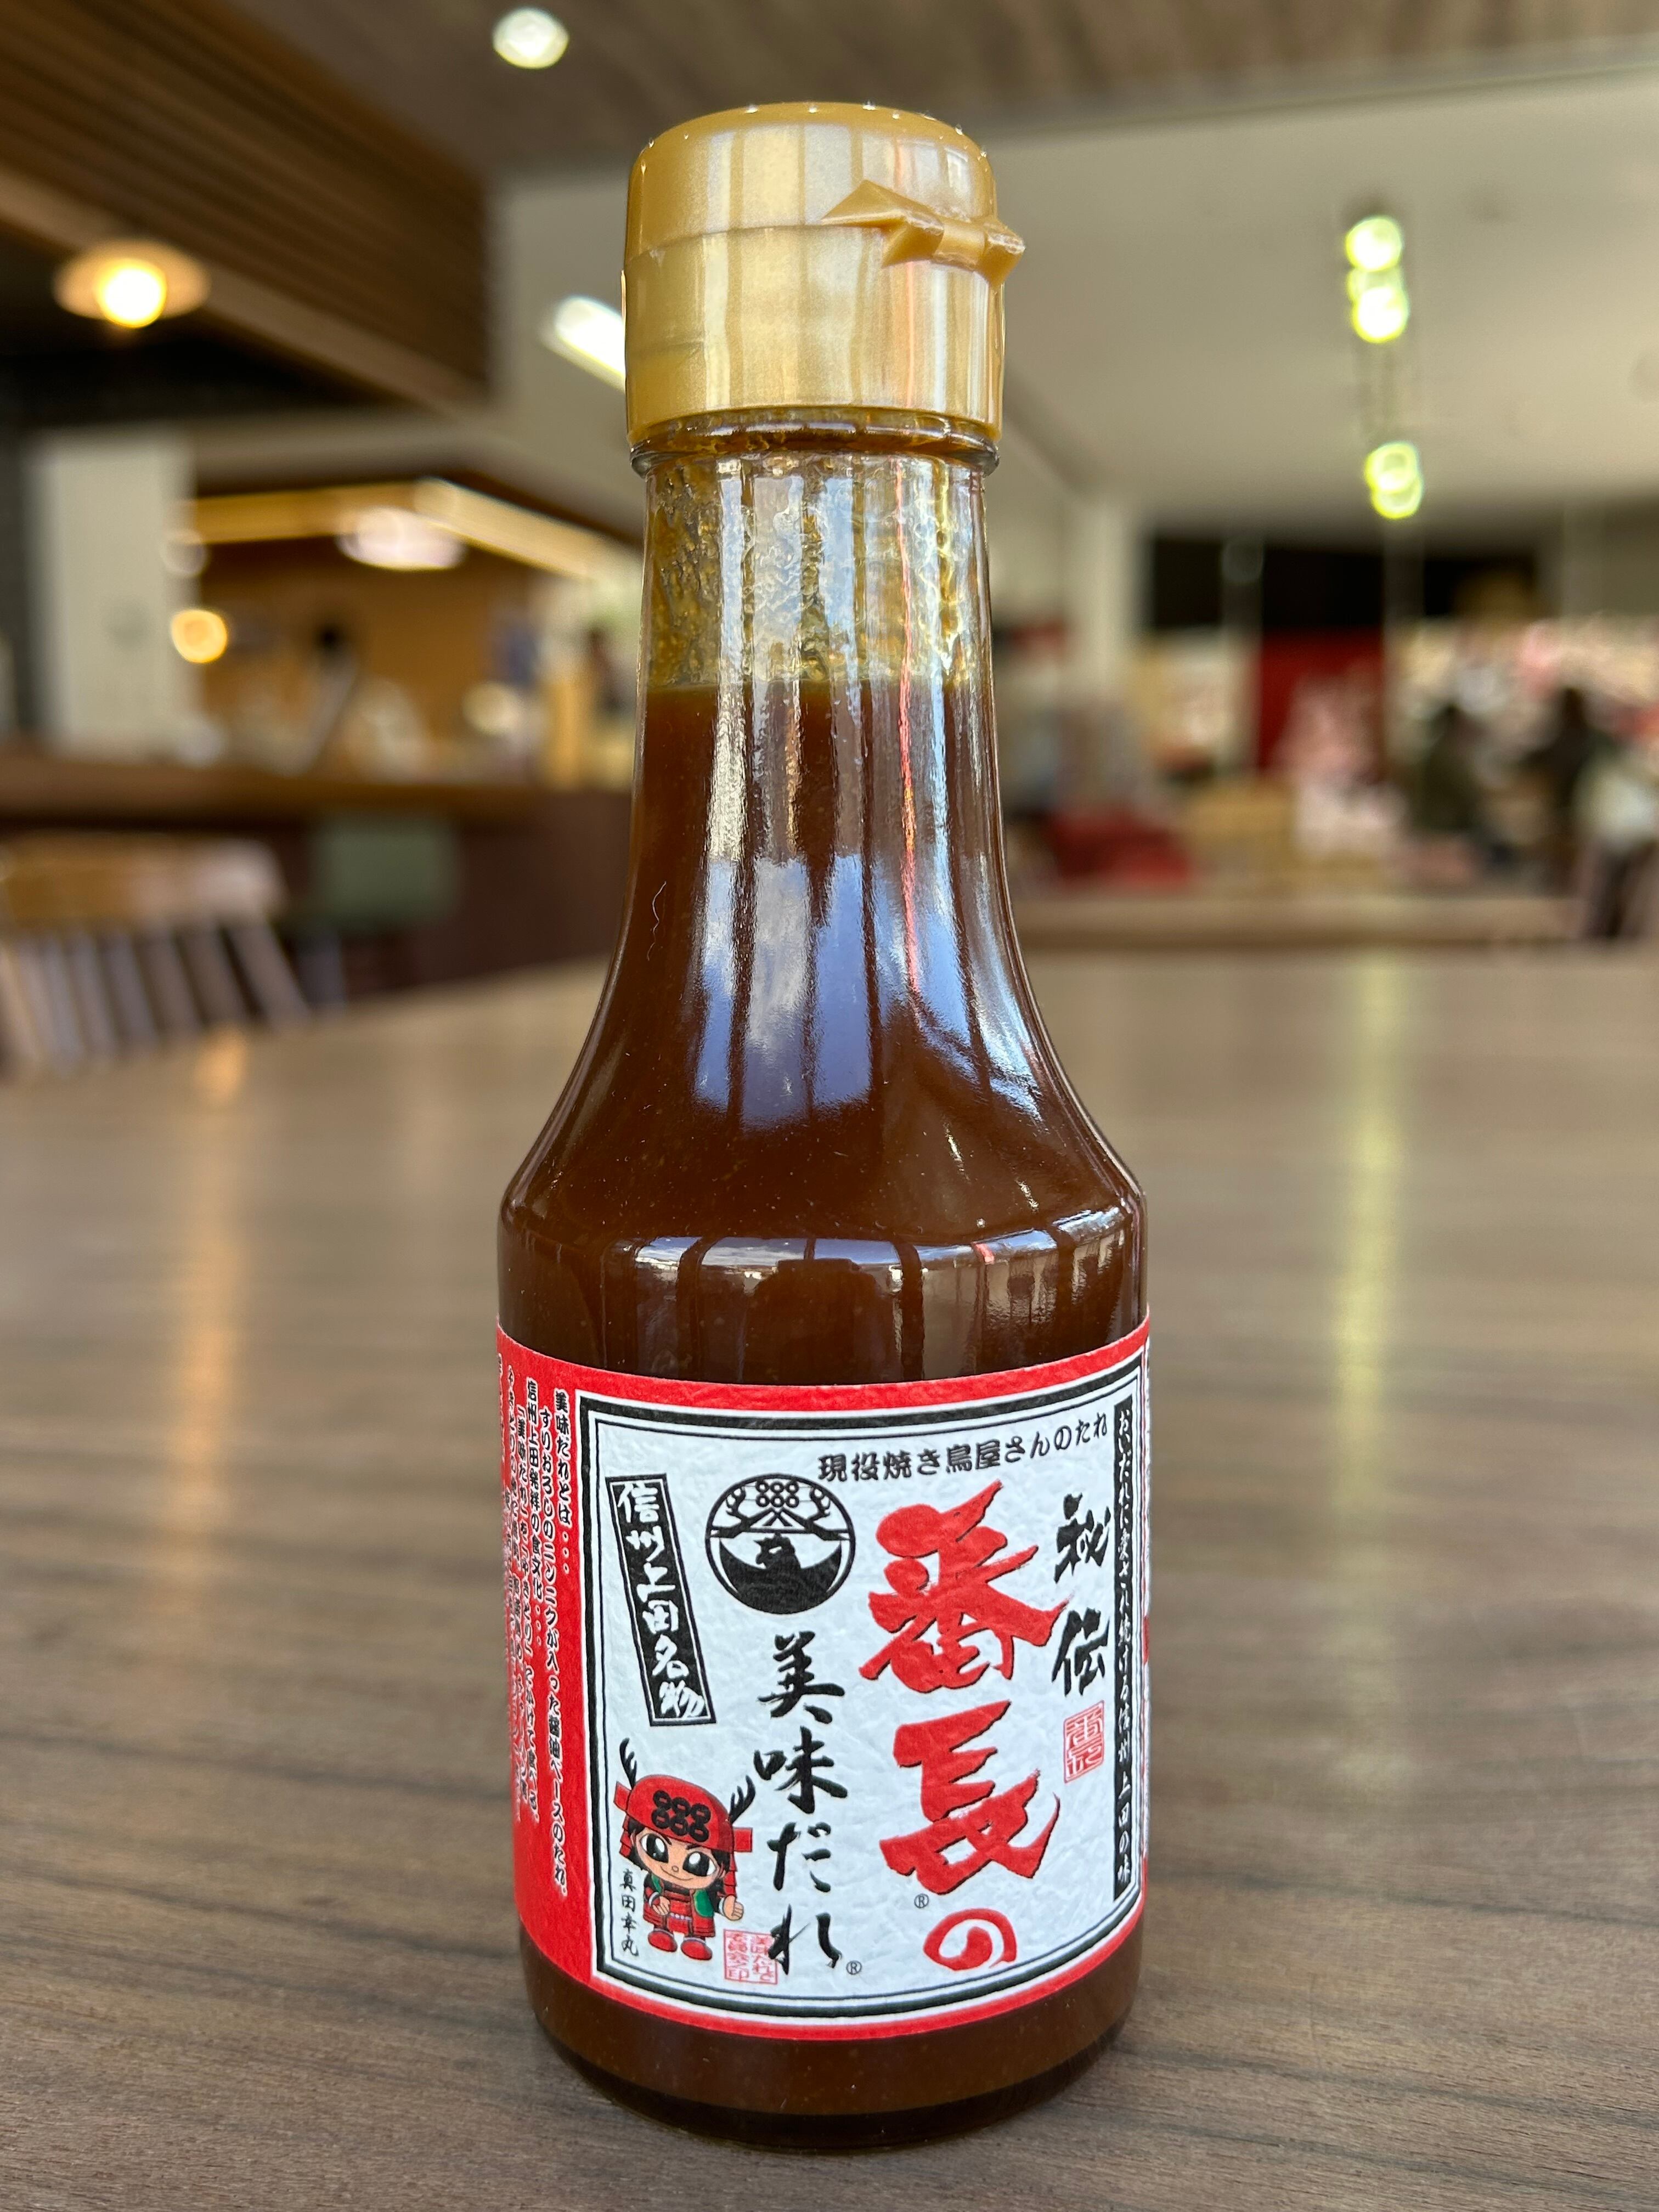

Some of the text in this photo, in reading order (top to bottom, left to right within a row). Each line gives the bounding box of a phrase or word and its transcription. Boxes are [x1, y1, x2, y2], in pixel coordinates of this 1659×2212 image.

[818, 1412, 1108, 1481] 現役焼き鳥屋さんのたれ
[617, 1483, 706, 1719] 信州上田名物
[1051, 1492, 1110, 1697] 秘伝
[753, 1630, 848, 1976] 美味だれ
[619, 1867, 640, 1957] 真田幸丸
